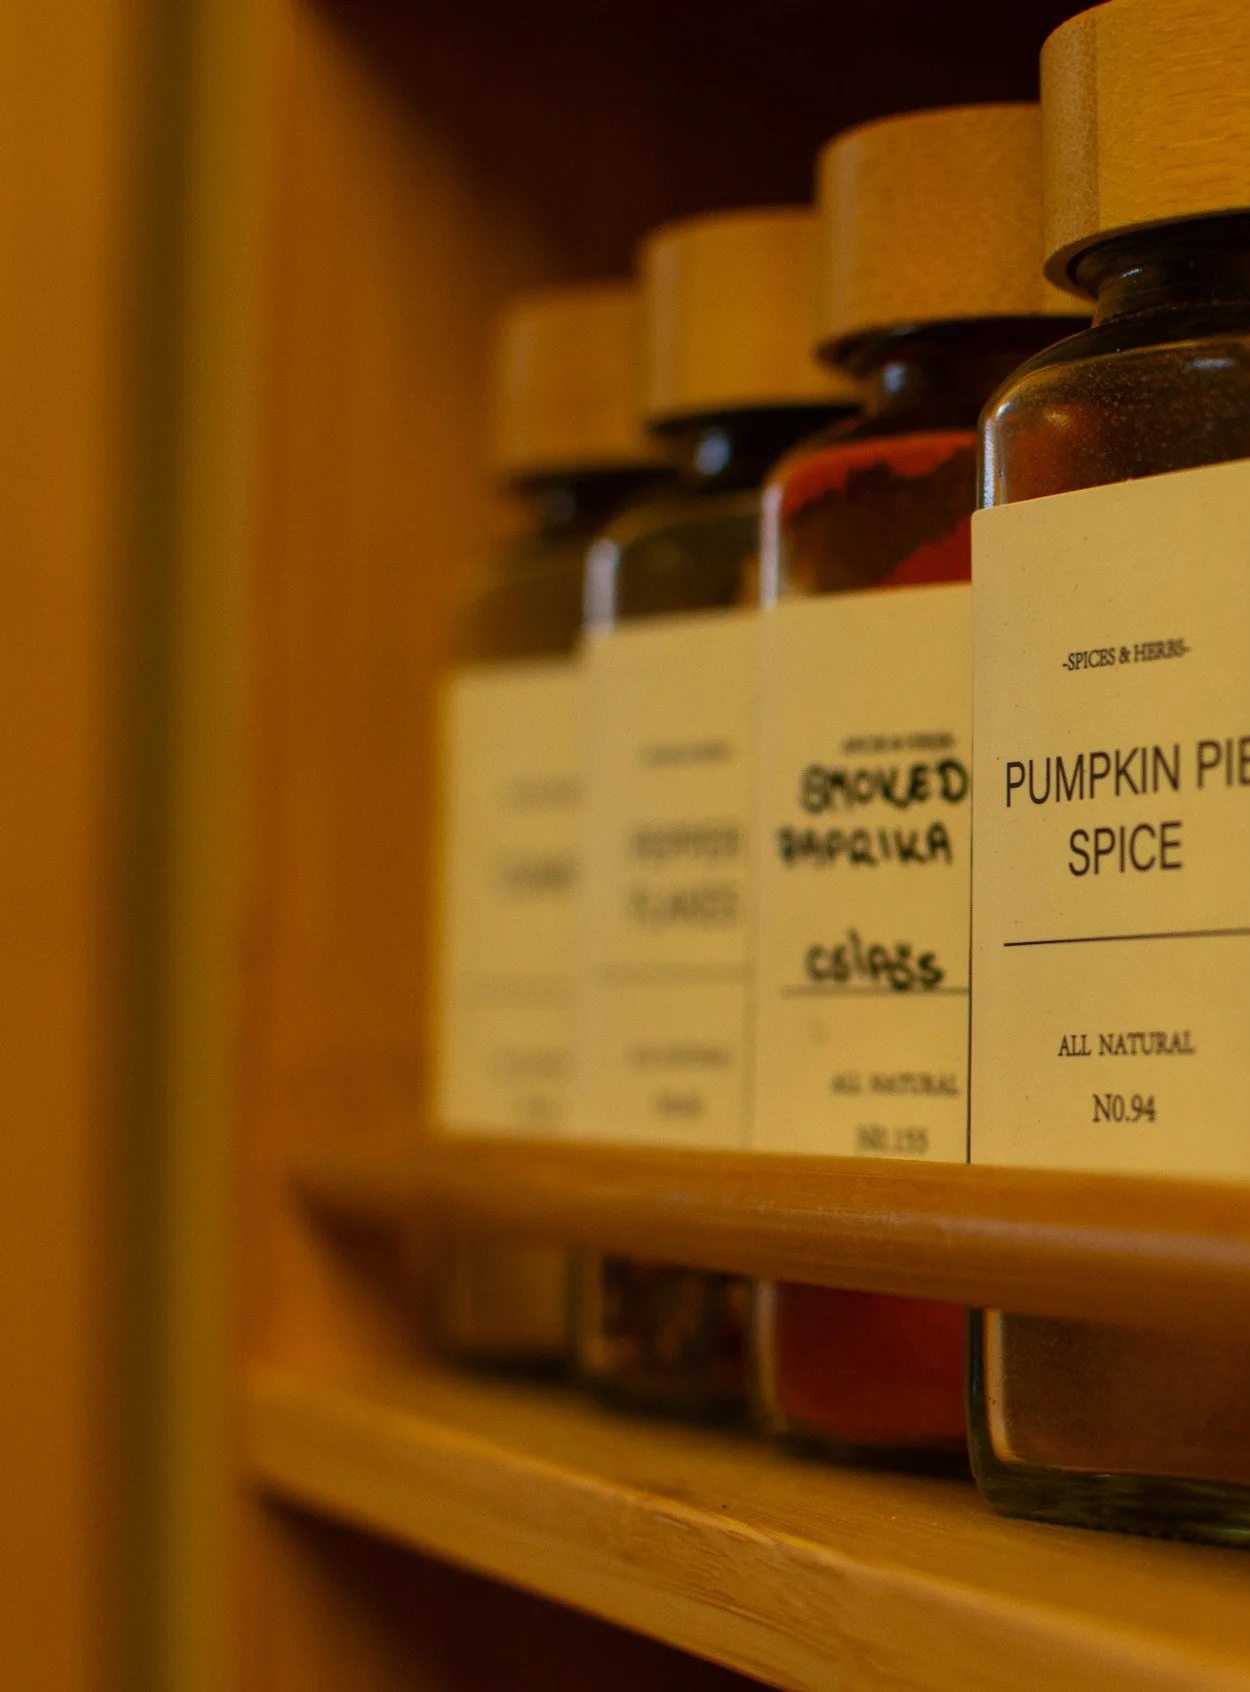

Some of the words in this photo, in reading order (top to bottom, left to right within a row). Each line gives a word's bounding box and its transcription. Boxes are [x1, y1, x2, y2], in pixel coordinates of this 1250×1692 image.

[1119, 646, 1130, 664] &
[801, 759, 969, 814] SMOKED
[1006, 743, 1181, 807] PUMPKIN
[777, 821, 953, 868] PAPRIKA
[1068, 821, 1184, 877] SPICE
[1057, 1034, 1091, 1056] ALL
[1099, 1031, 1195, 1056] NATURAL
[869, 1071, 959, 1097] NATURAL
